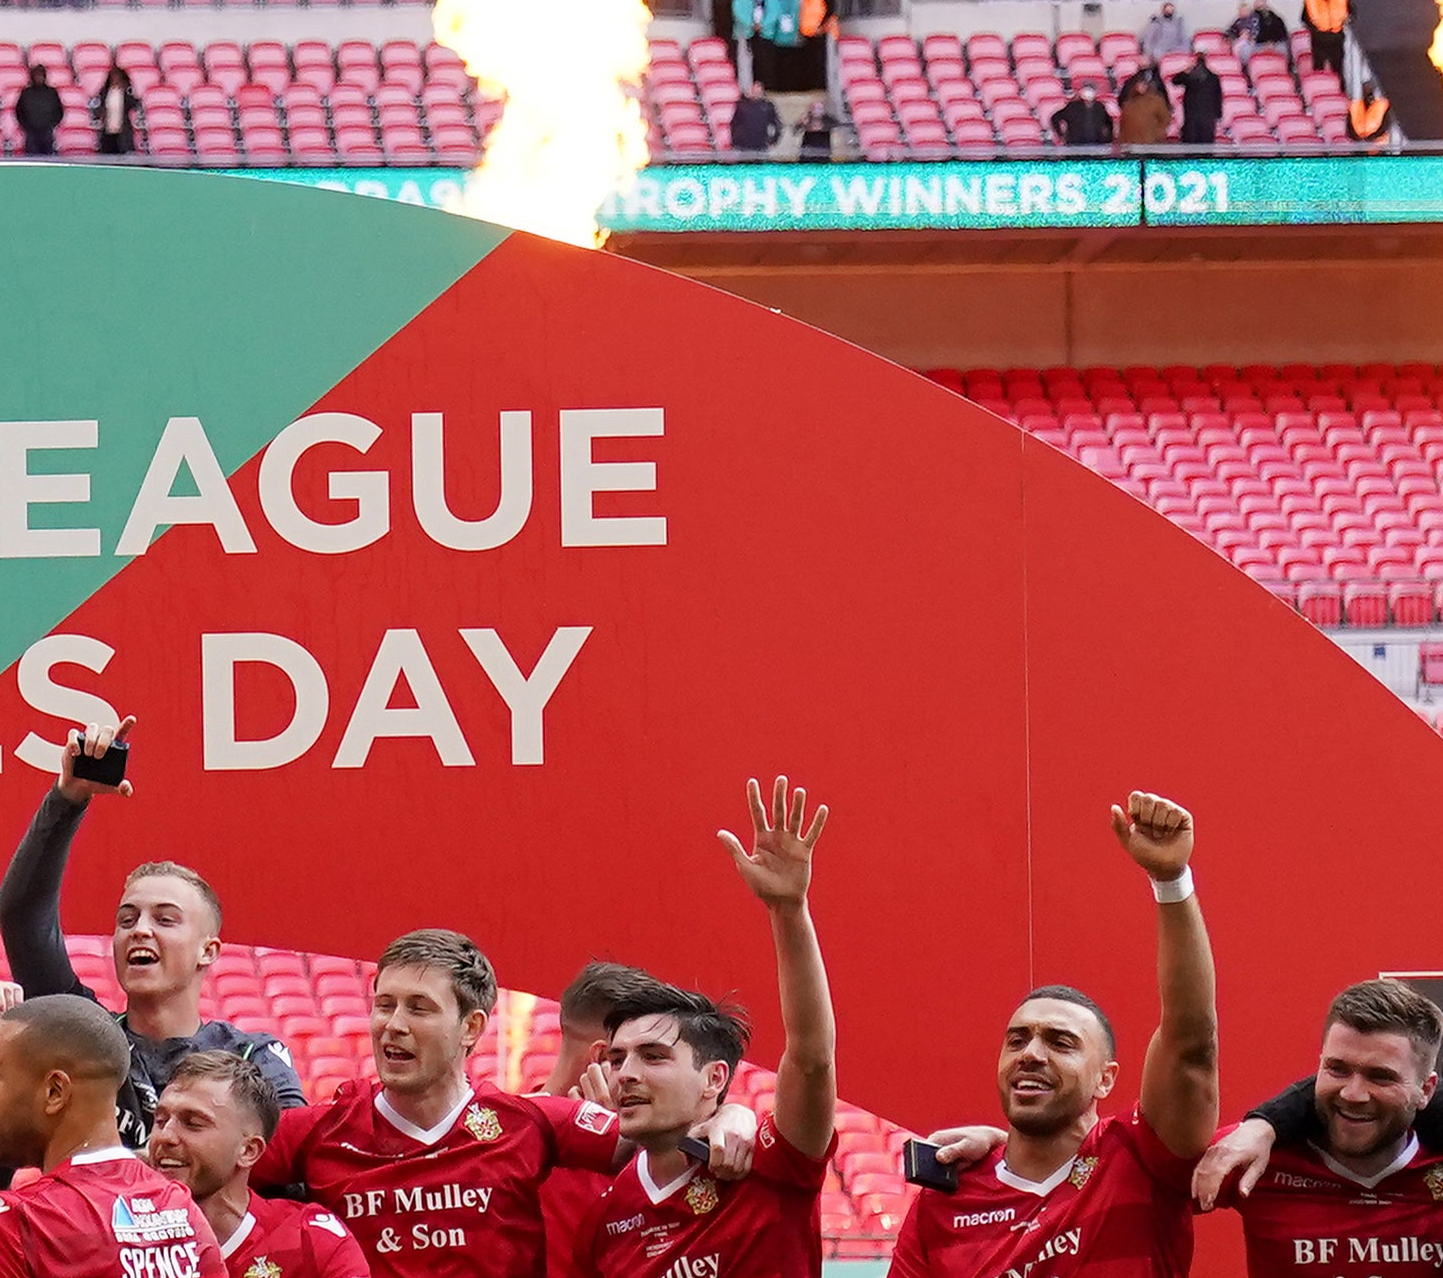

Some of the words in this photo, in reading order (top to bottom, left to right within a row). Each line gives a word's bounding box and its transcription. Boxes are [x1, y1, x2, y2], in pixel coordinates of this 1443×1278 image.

[829, 171, 1083, 217] WINNERS
[1101, 169, 1229, 215] 2021
[201, 624, 595, 771] DAY
[343, 1189, 387, 1220] BF
[394, 1183, 494, 1215] Mulley
[953, 1207, 1016, 1229] macron
[375, 1226, 403, 1254] &
[412, 1223, 467, 1252] Son
[1292, 1237, 1339, 1265] BF
